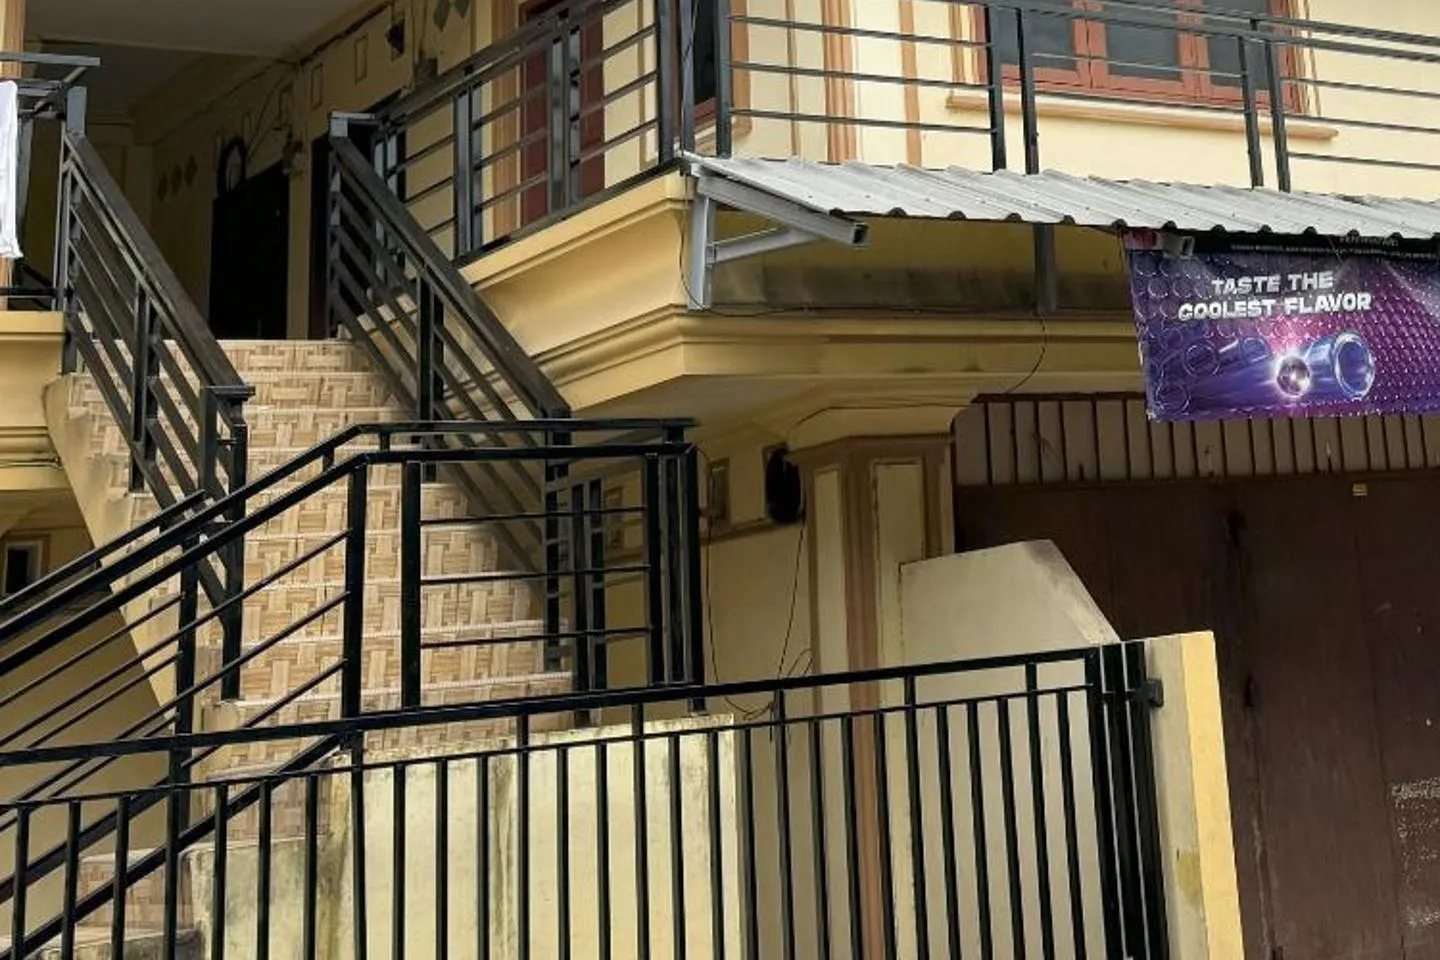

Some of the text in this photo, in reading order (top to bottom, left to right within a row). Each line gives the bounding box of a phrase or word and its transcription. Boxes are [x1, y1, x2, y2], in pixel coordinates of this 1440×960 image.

[1211, 270, 1334, 295] TASTE THE
[1178, 292, 1372, 321] COOLEST FLAVOR
